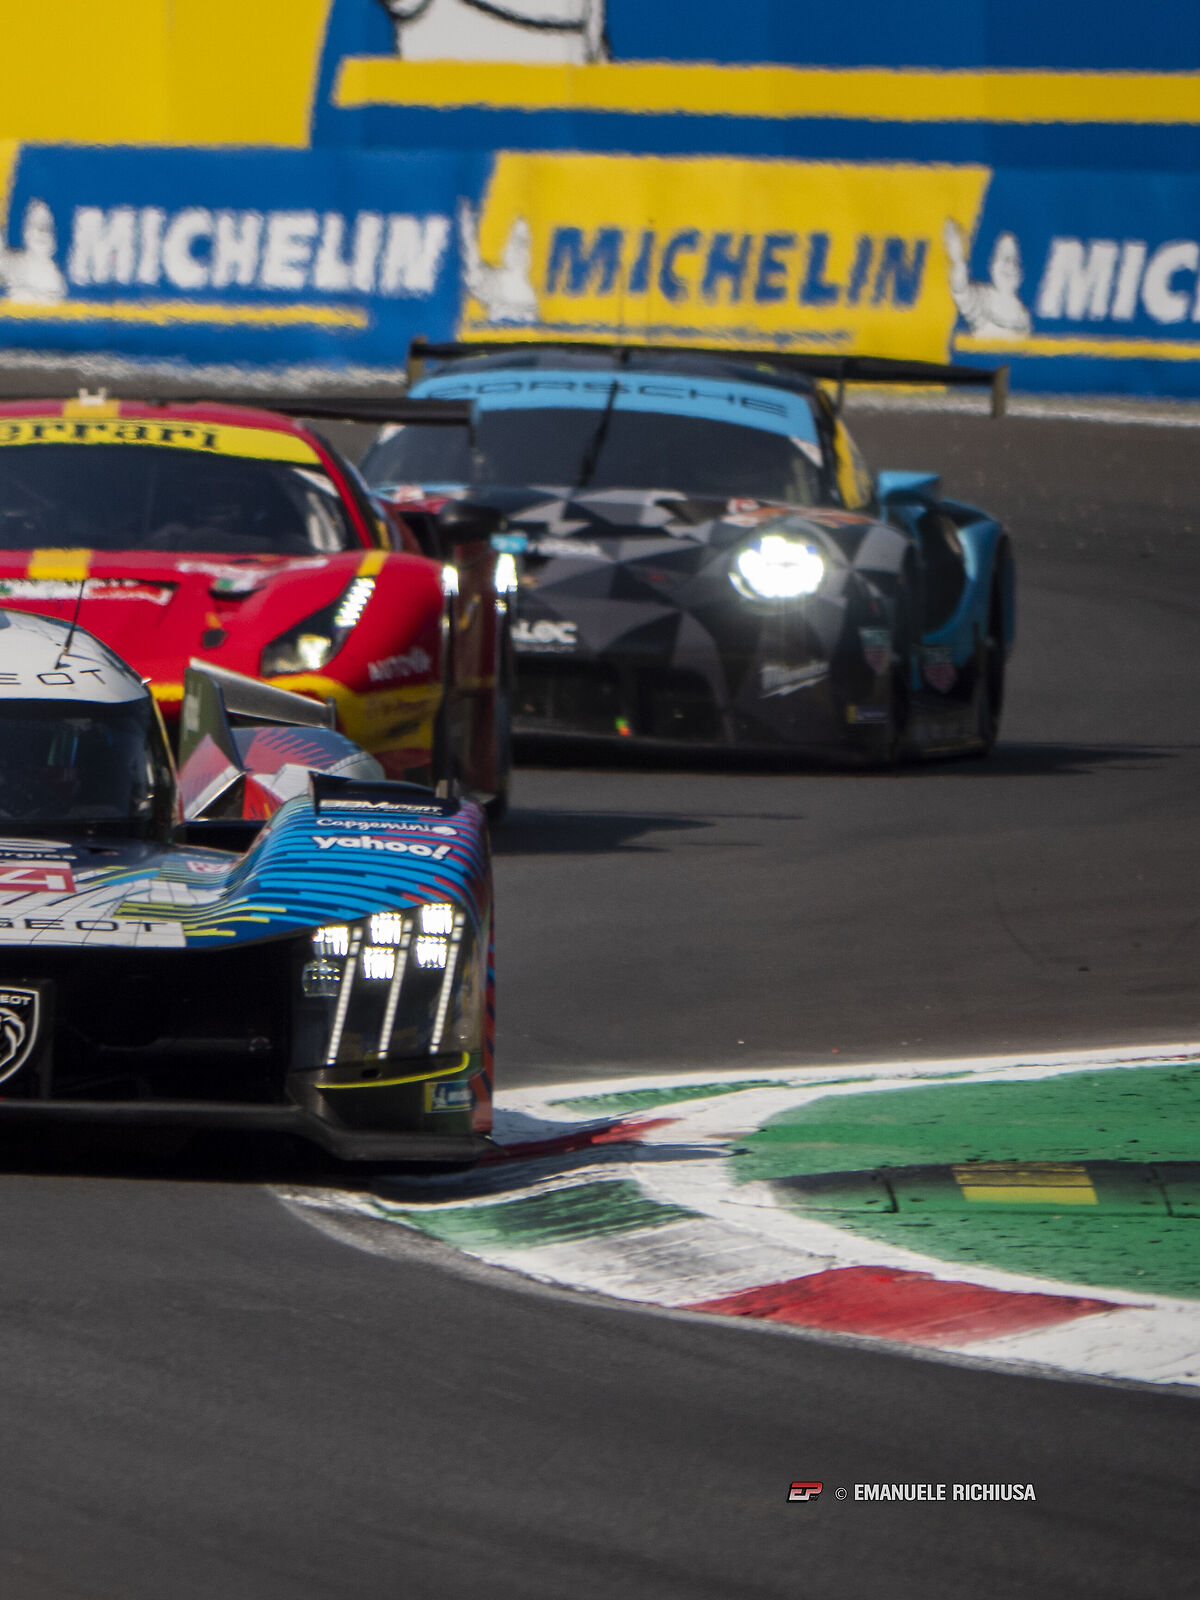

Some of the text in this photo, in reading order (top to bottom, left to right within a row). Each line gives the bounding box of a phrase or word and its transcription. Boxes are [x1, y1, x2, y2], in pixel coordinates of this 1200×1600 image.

[68, 204, 450, 296] MICHELIN
[545, 226, 931, 308] MICHELIN
[1036, 235, 1200, 324] MIC
[427, 378, 789, 418] PORSCHE
[311, 835, 451, 860] yahoo!
[315, 817, 430, 832] Capgemini
